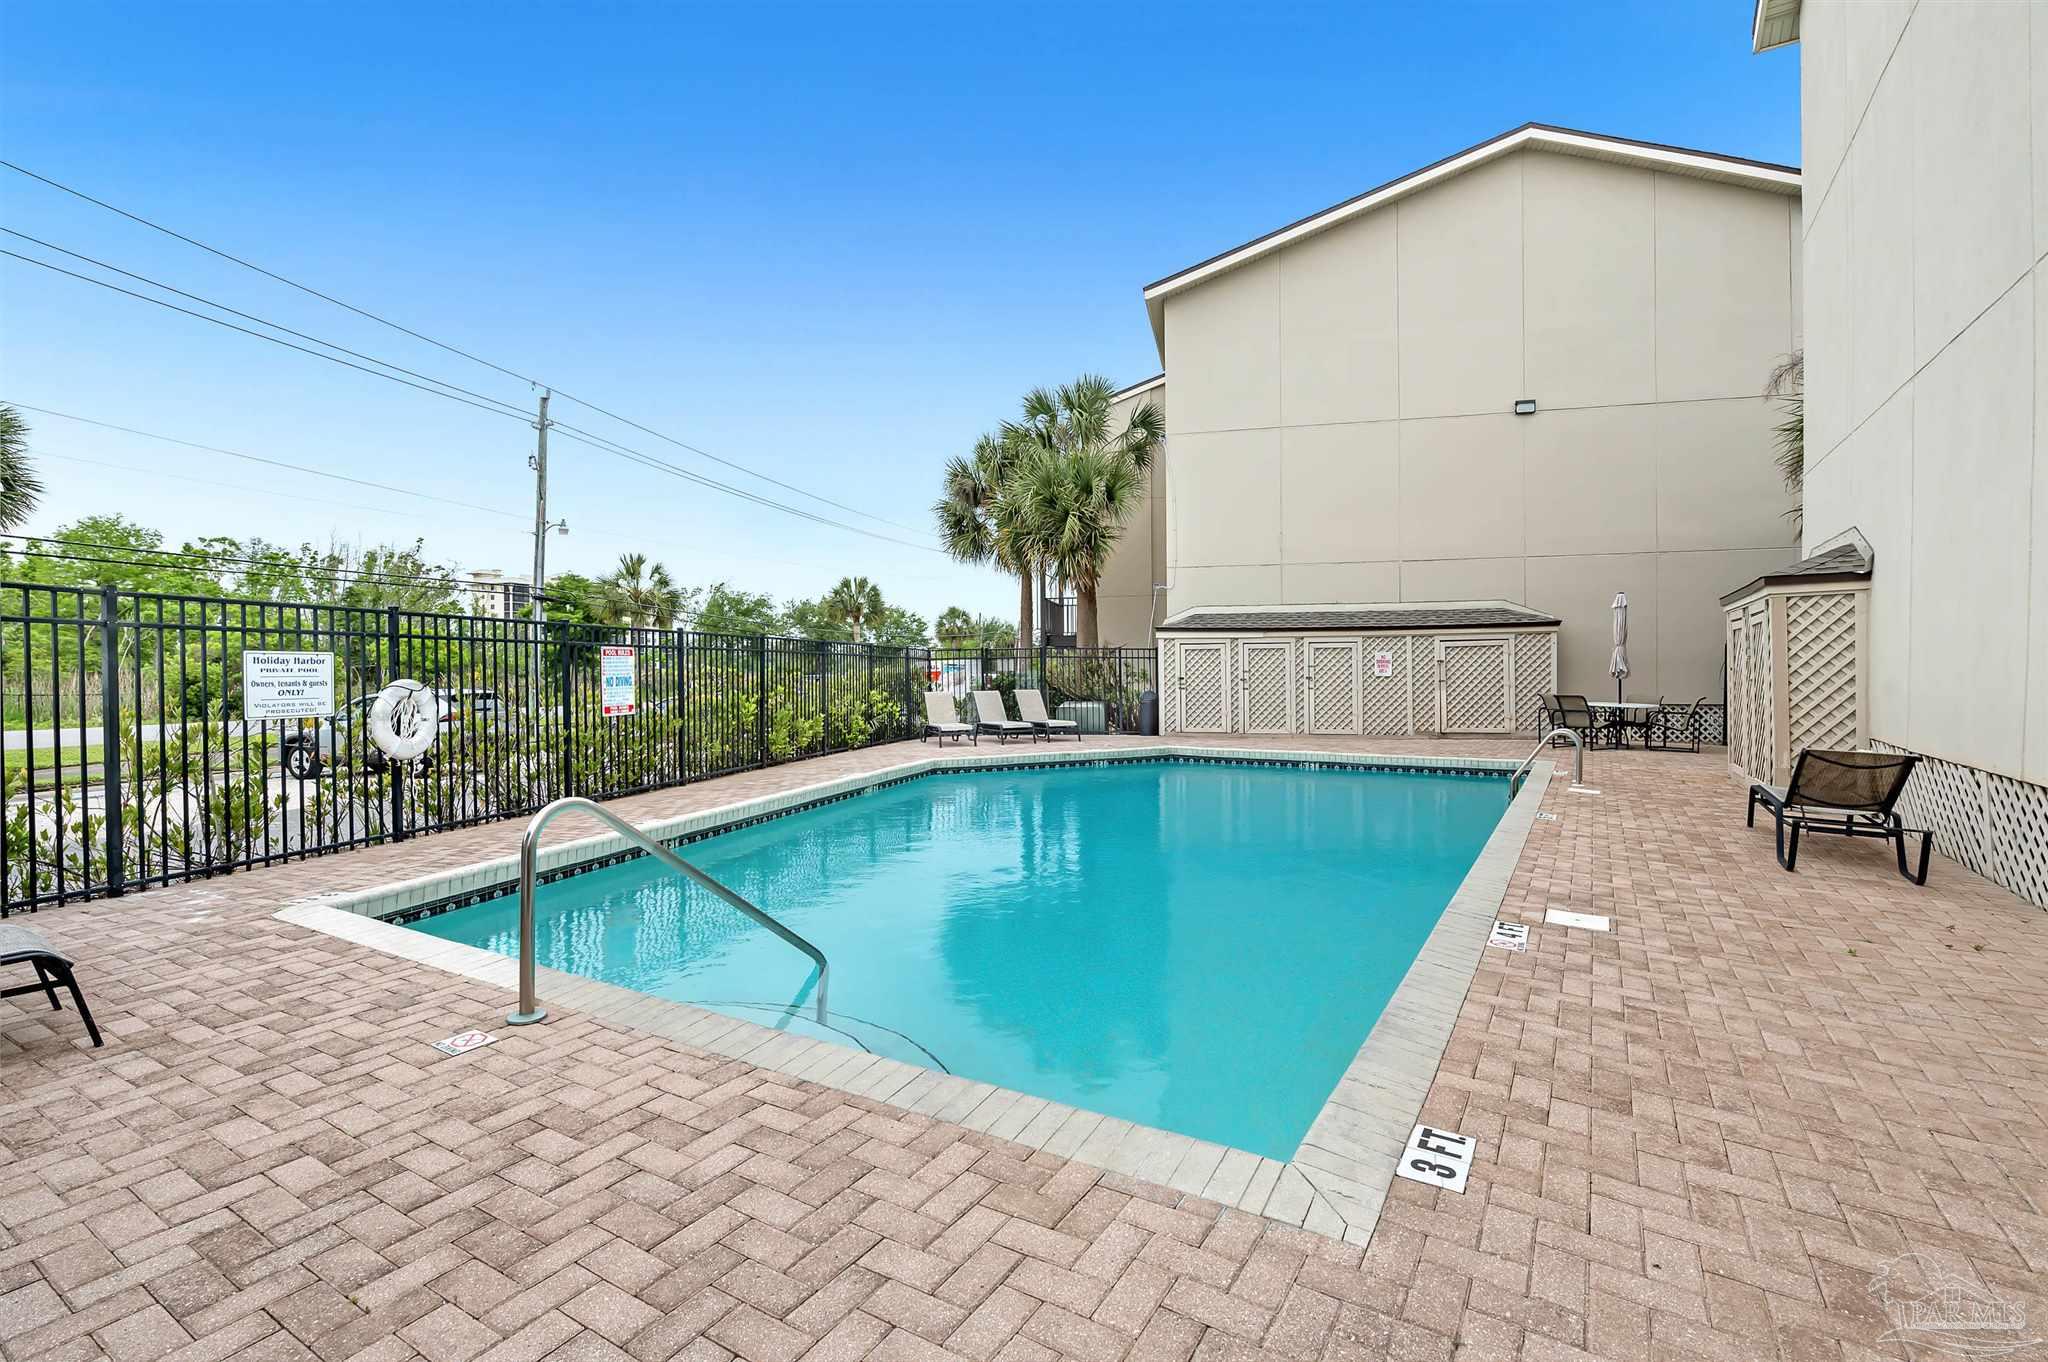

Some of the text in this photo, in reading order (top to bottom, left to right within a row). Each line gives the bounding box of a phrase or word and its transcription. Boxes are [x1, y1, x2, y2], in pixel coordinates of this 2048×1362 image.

[252, 656, 326, 666] Holiday Harbor
[250, 680, 276, 688] Owners,
[308, 680, 328, 688] guests
[606, 675, 632, 687] NO DIVING
[1410, 1159, 1457, 1179] 3
